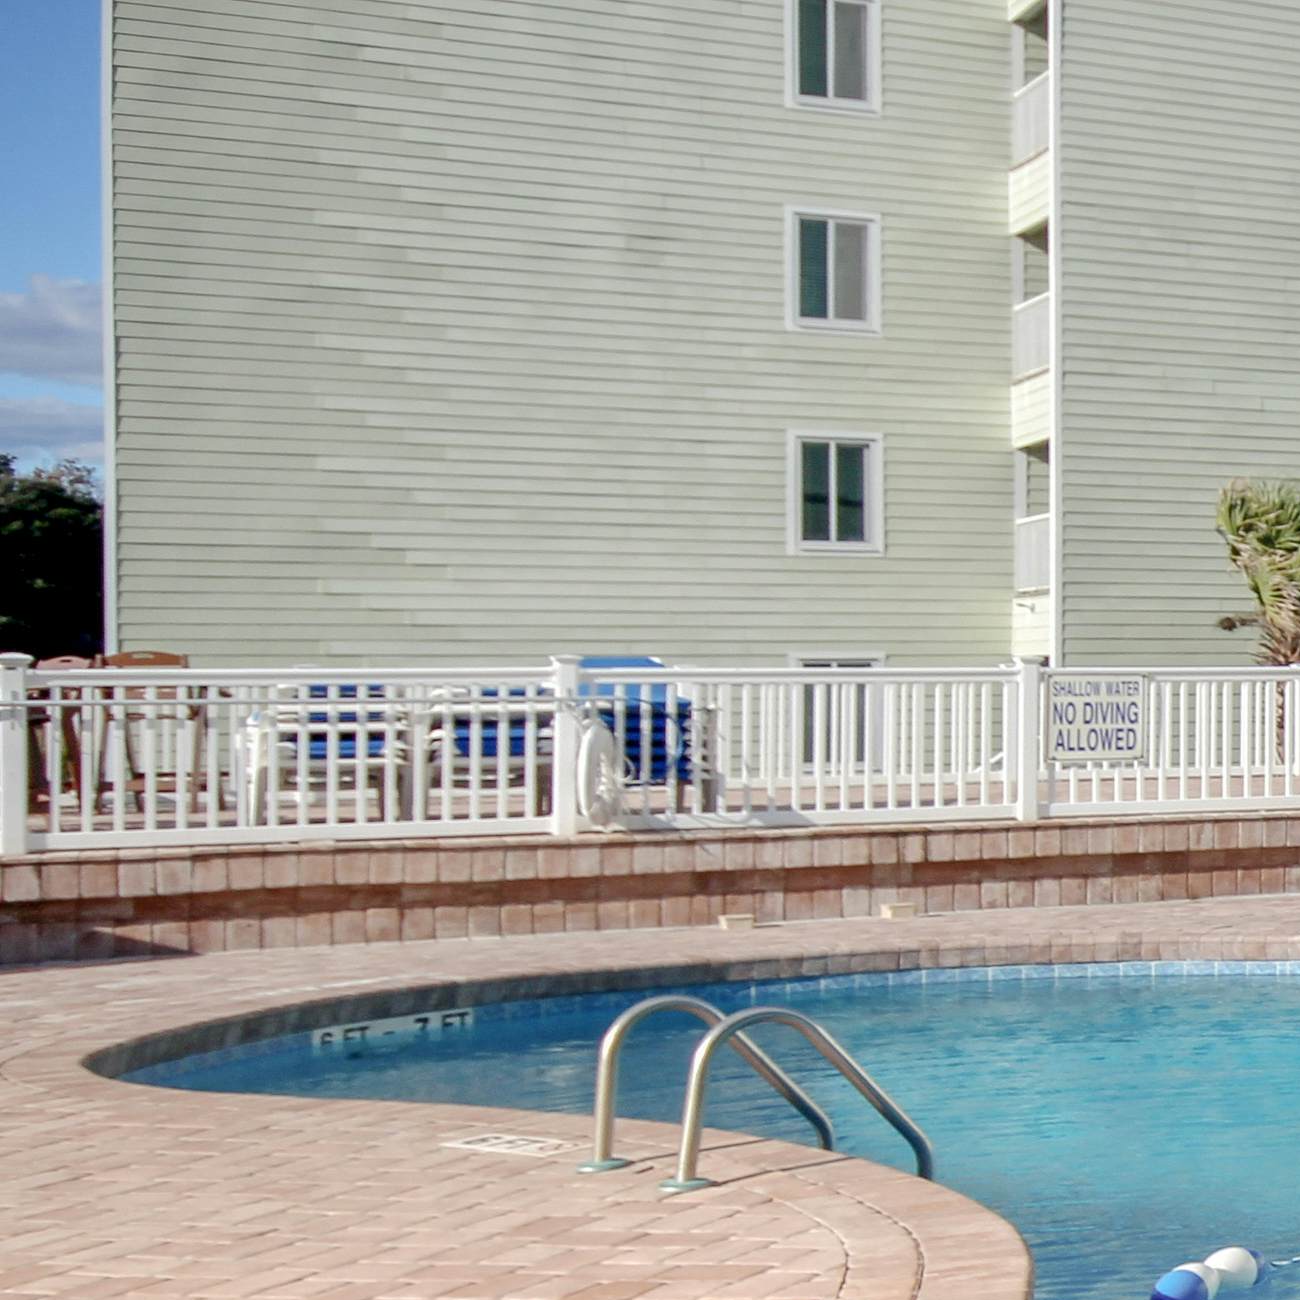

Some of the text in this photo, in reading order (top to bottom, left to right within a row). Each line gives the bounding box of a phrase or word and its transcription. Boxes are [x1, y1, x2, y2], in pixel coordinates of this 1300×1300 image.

[1053, 681, 1139, 697] SHALLOW WATER
[1053, 701, 1139, 725] NO DIVING
[1055, 728, 1137, 751] ALLOWED
